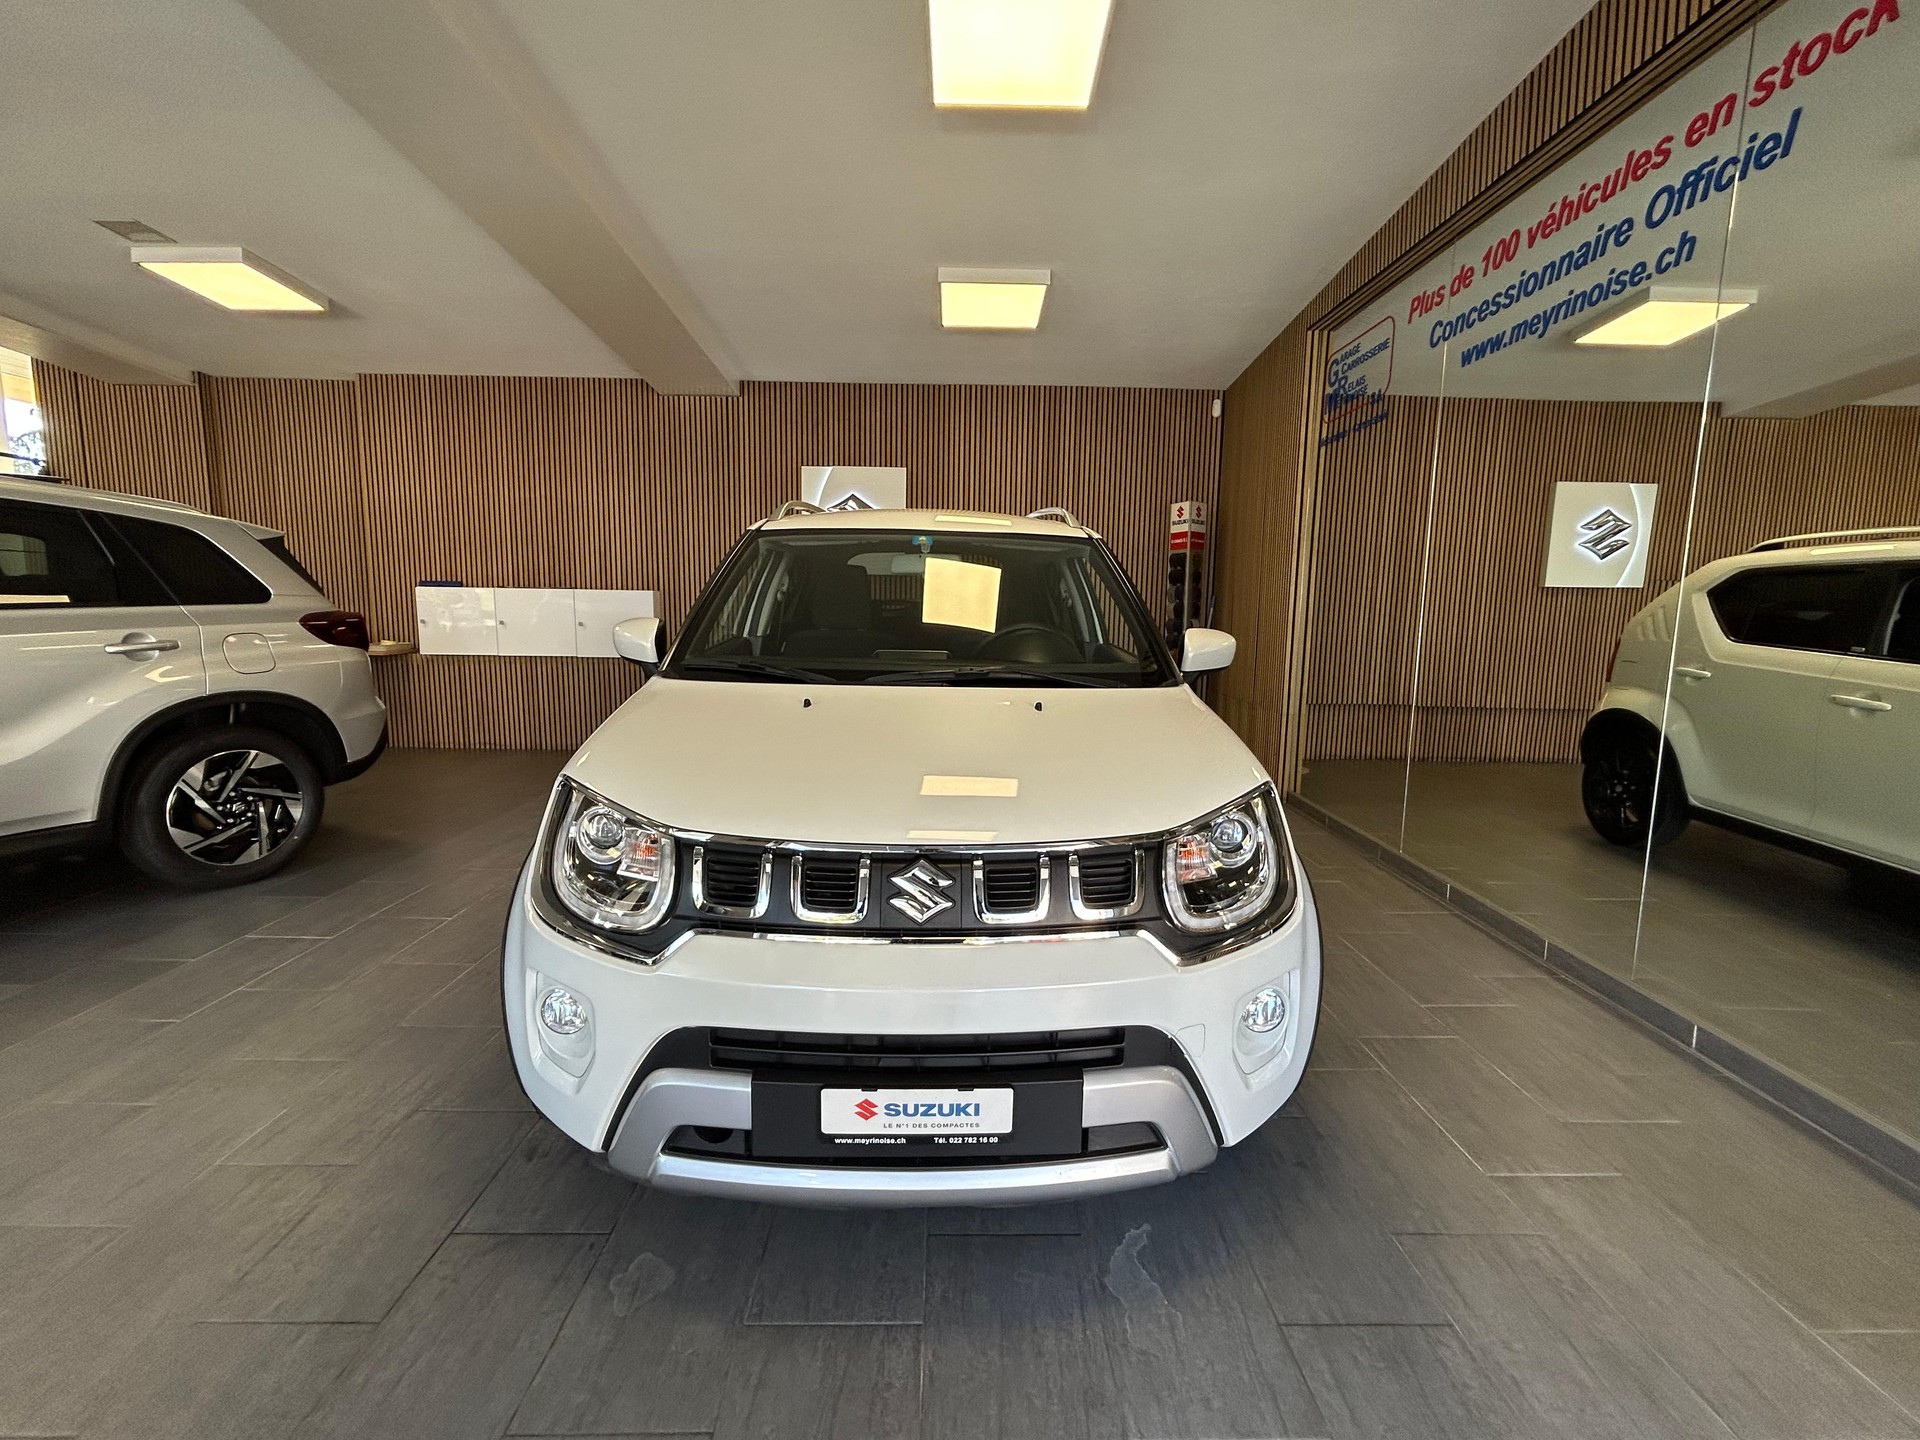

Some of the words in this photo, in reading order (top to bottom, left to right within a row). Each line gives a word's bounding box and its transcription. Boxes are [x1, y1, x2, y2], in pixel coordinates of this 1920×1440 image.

[1407, 284, 1446, 325] Plus
[1449, 263, 1475, 297] de
[1481, 228, 1521, 278] 100
[1527, 134, 1675, 250] véhicules
[1684, 92, 1739, 147] en
[1429, 216, 1635, 349] Concessionnaire
[1645, 106, 1803, 230] Officiel
[1460, 230, 1697, 368] www.meyrinoise.ch
[834, 1137, 906, 1145] www.meyrinoise.ch
[949, 1136, 963, 1144] 022
[964, 1136, 978, 1144] 782
[884, 1103, 980, 1117] SUZUKI
